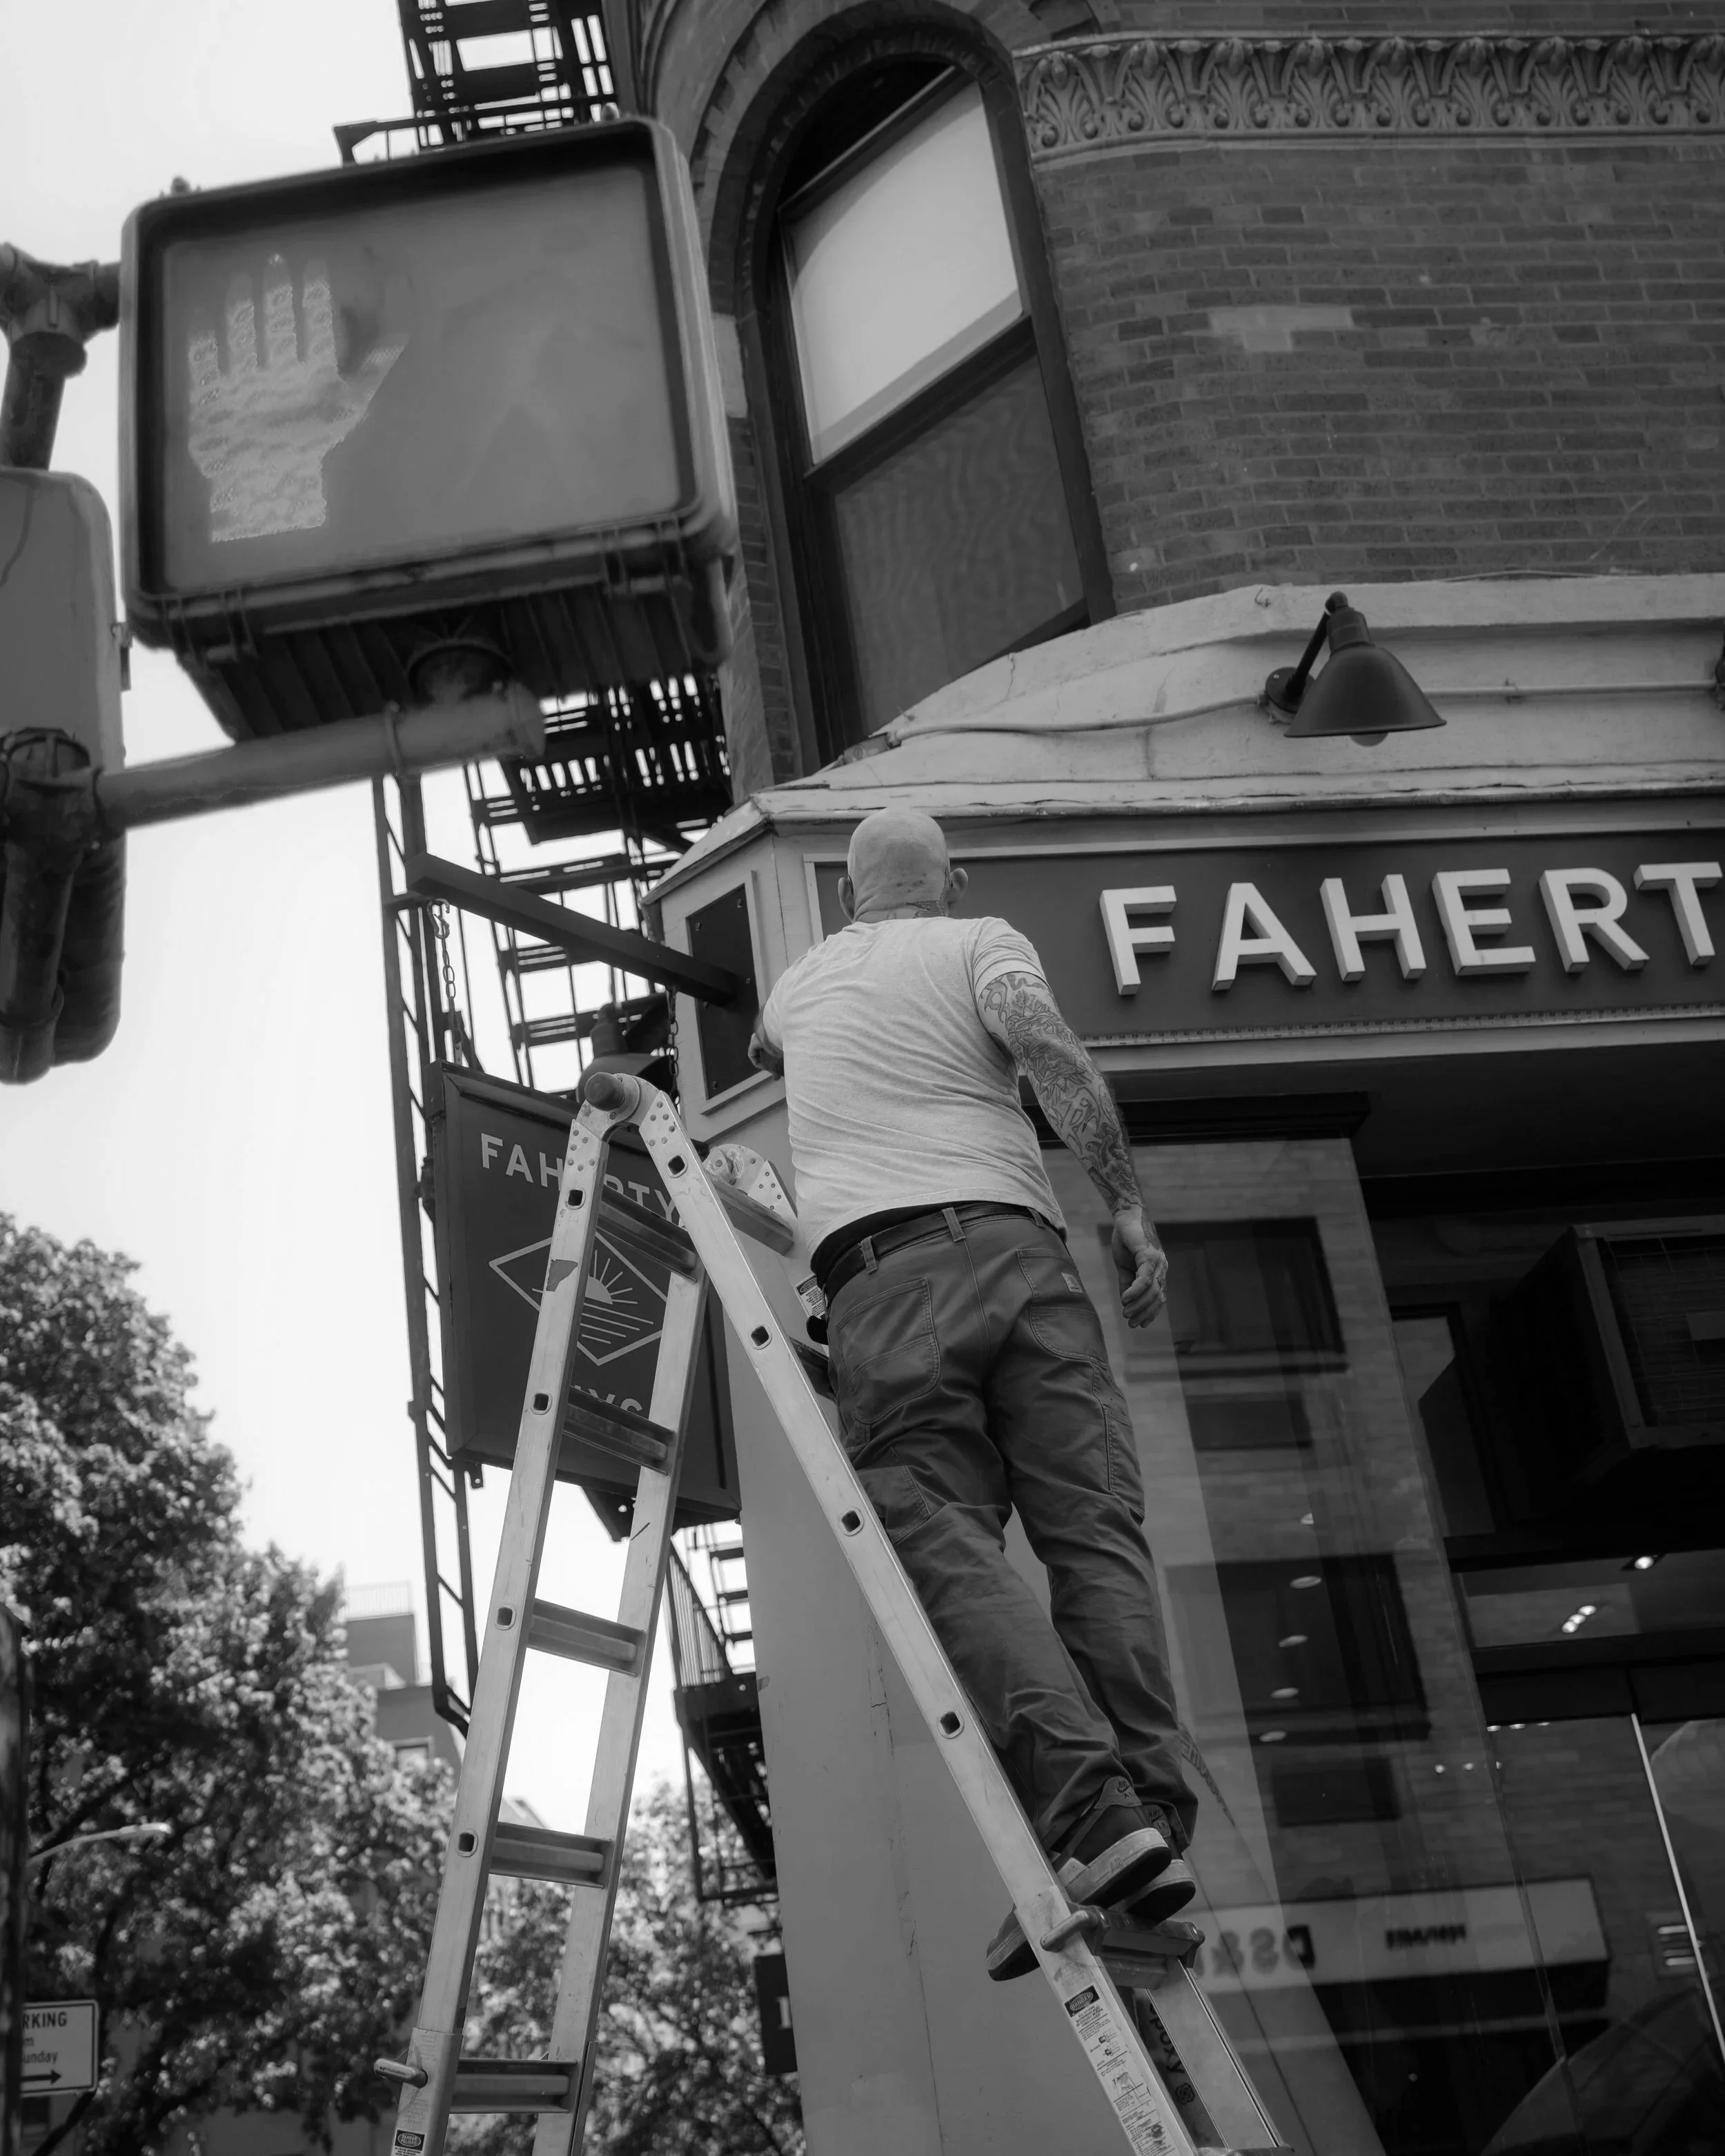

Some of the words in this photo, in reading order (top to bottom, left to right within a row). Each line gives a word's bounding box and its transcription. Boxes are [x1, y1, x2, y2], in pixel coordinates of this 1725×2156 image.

[1100, 862, 1722, 997] FAHERT
[481, 1133, 676, 1223] FAHTY
[22, 2011, 67, 2030] RKING
[21, 2050, 58, 2065] unday
